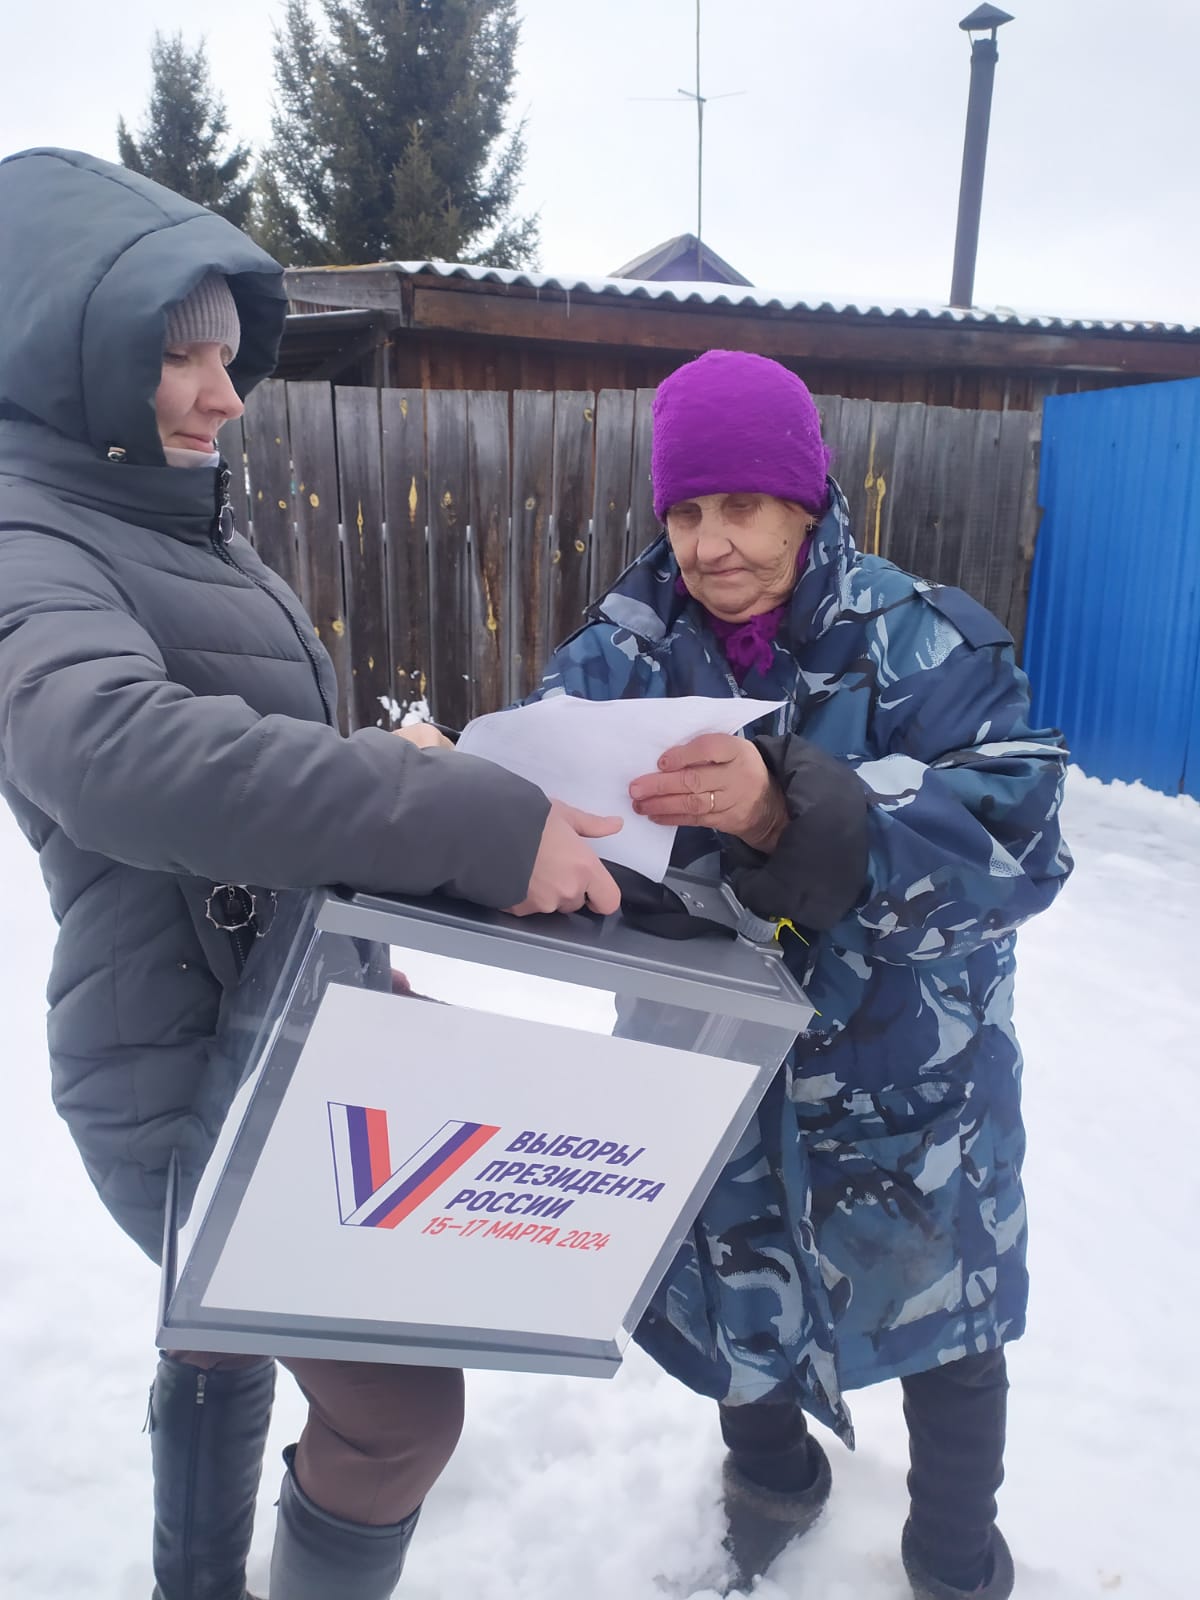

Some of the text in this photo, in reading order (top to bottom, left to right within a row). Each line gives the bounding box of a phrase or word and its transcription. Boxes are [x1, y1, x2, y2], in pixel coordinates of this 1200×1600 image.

[504, 1130, 646, 1167] ВЫБОРЫ
[474, 1160, 666, 1203] ПРЕЗИДЕНТА
[444, 1188, 576, 1220] РОССИИ
[482, 1220, 560, 1246] МАРТА
[556, 1230, 613, 1252] 2024
